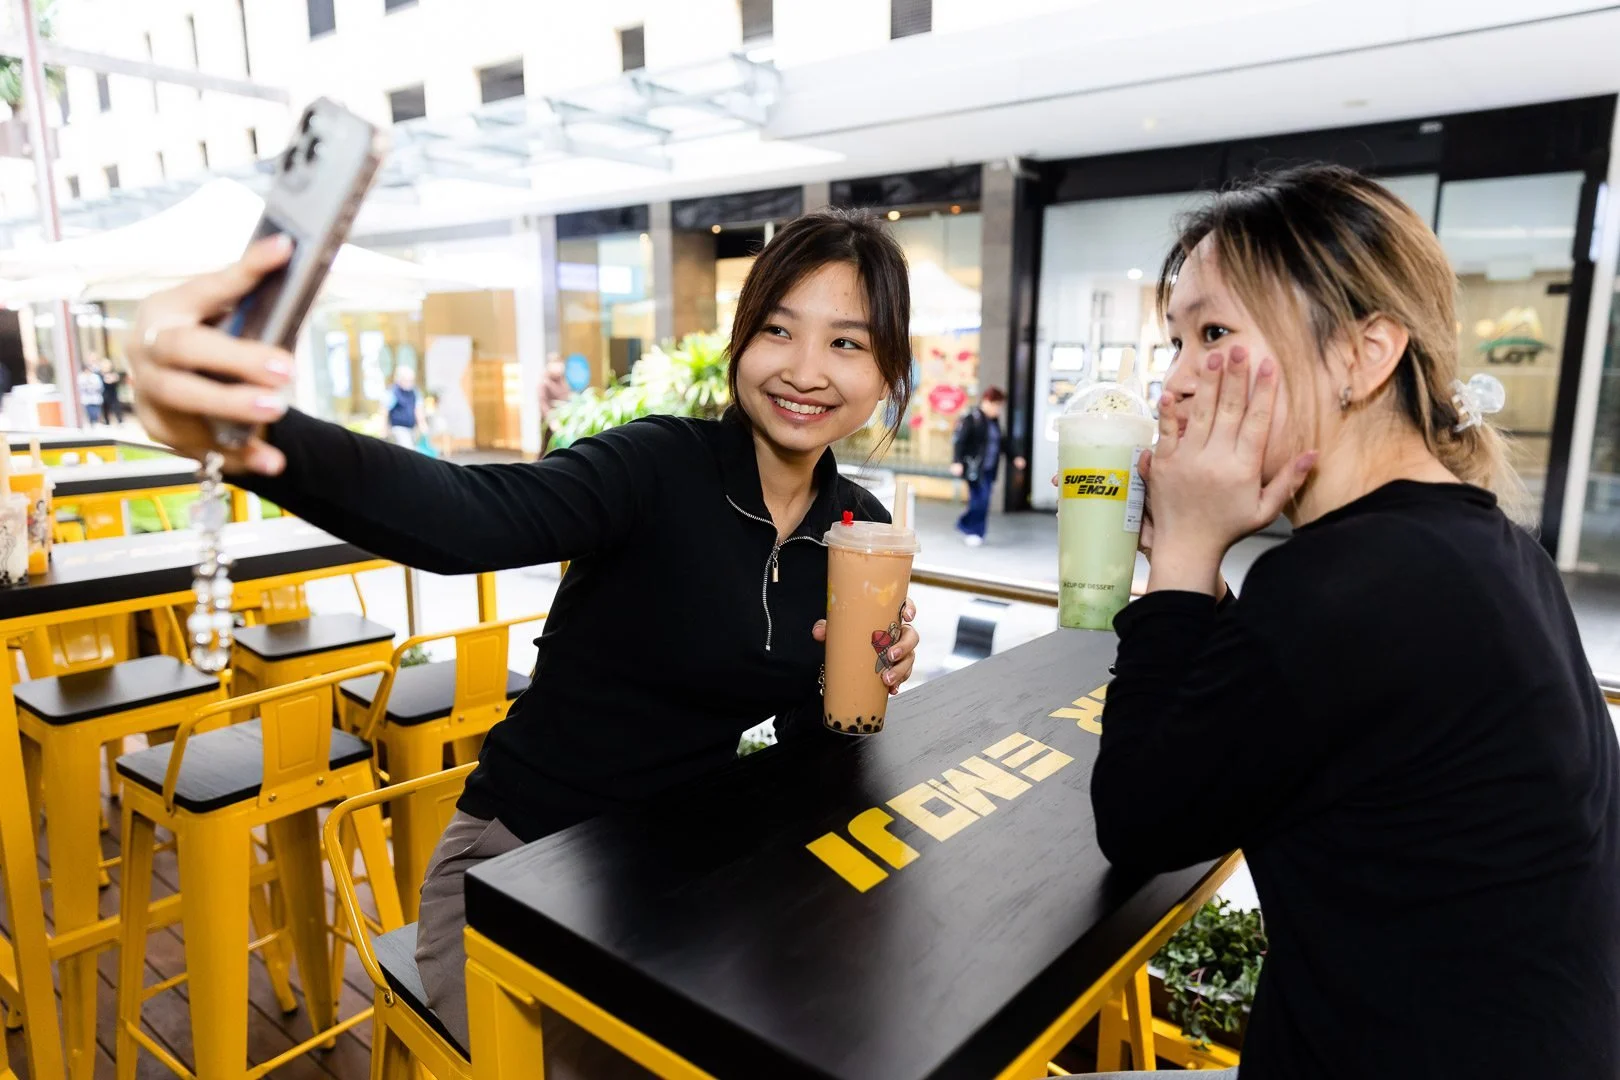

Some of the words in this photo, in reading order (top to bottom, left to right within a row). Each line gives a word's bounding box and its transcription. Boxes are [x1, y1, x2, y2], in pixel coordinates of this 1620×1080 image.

[1064, 475, 1105, 484] SUPER
[1077, 485, 1119, 496] EMOJI
[1087, 583, 1115, 591] DESSERT
[805, 731, 1075, 894] EMOJI
